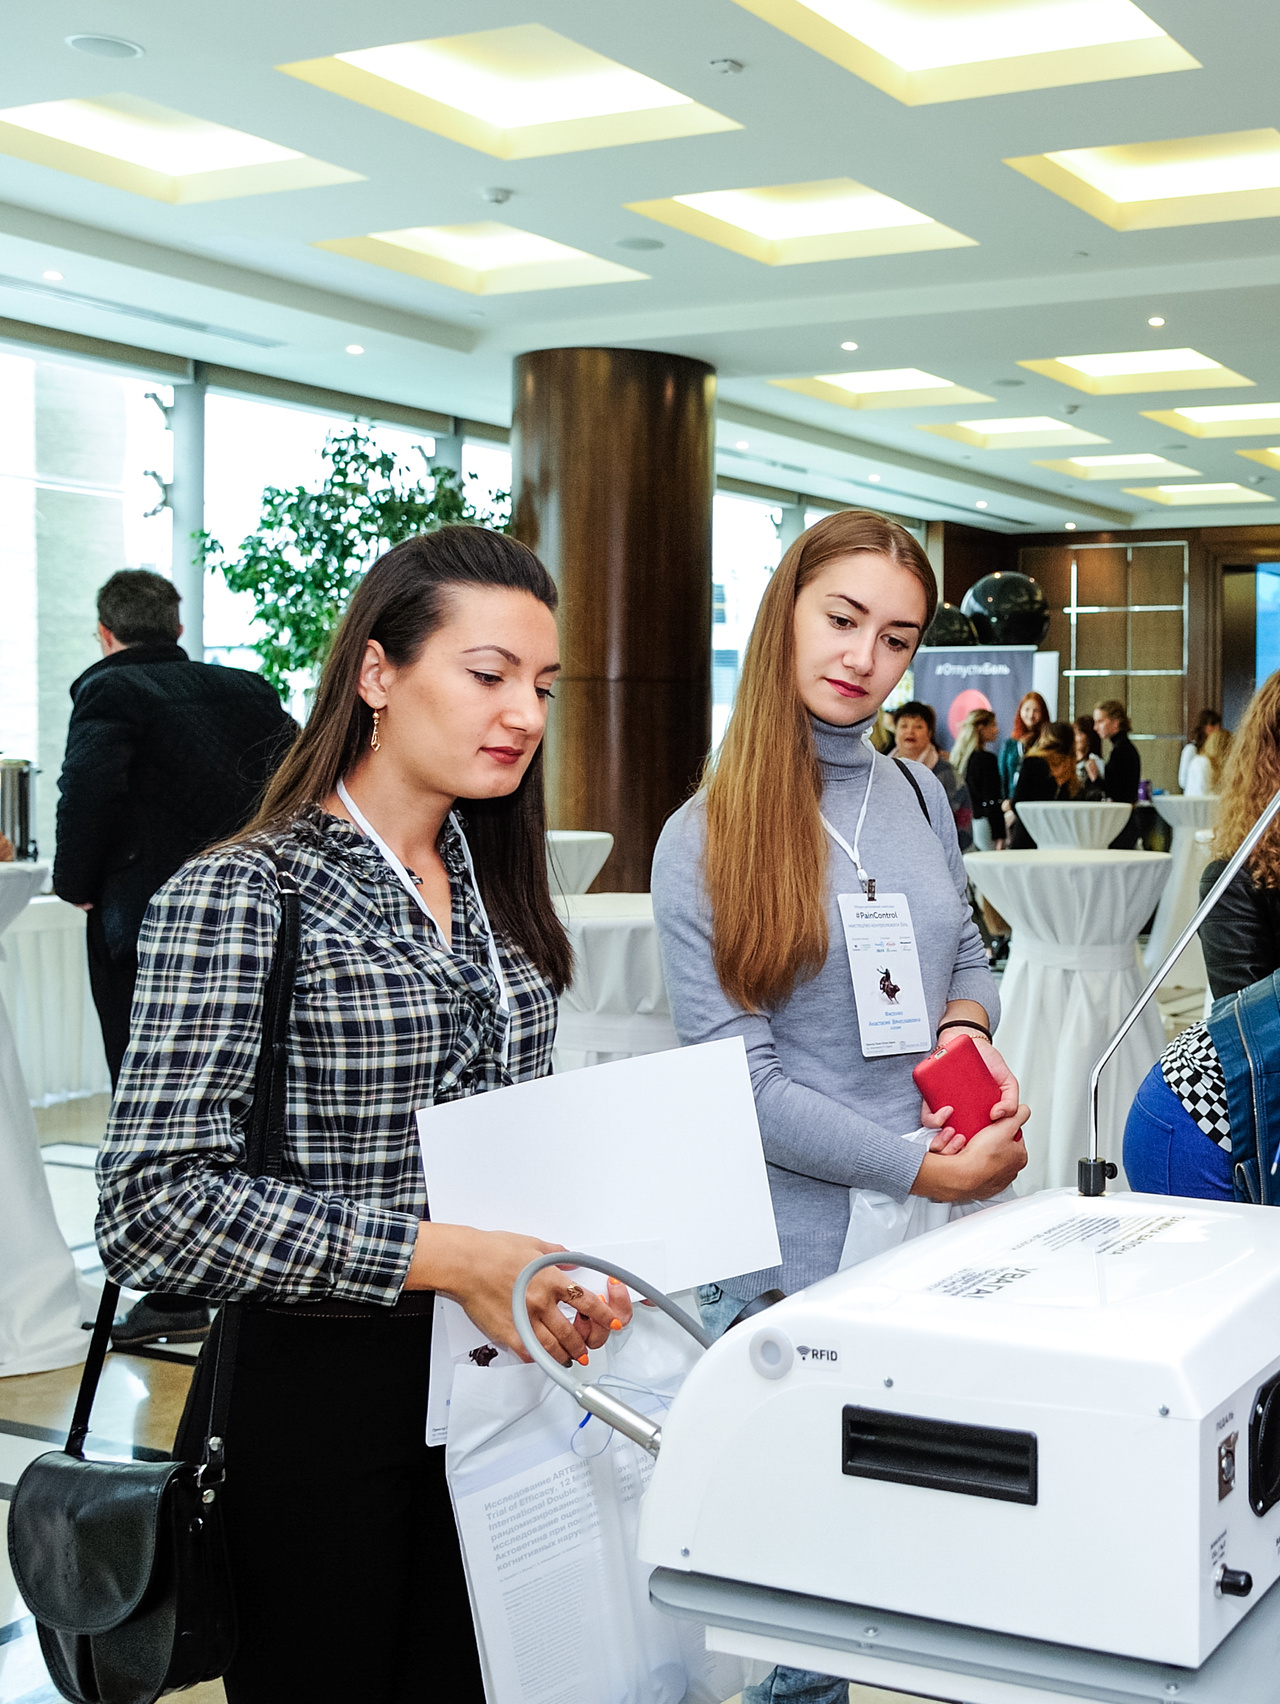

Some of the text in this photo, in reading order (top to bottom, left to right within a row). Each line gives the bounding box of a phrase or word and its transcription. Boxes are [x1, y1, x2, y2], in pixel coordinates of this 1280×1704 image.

[935, 662, 1011, 679] #ОтпустиБоль
[856, 911, 898, 919] #PainControl
[962, 1267, 1038, 1299] УВАГА!
[811, 1348, 838, 1361] RFID
[484, 1476, 551, 1512] Исследование
[487, 1505, 507, 1521] Trial
[508, 1501, 519, 1512] of
[559, 1477, 571, 1489] 12
[488, 1500, 545, 1531] International
[492, 1517, 560, 1551] исследование
[495, 1533, 548, 1561] Актовегина
[549, 1525, 566, 1540] при
[497, 1540, 557, 1572] когнитивных
